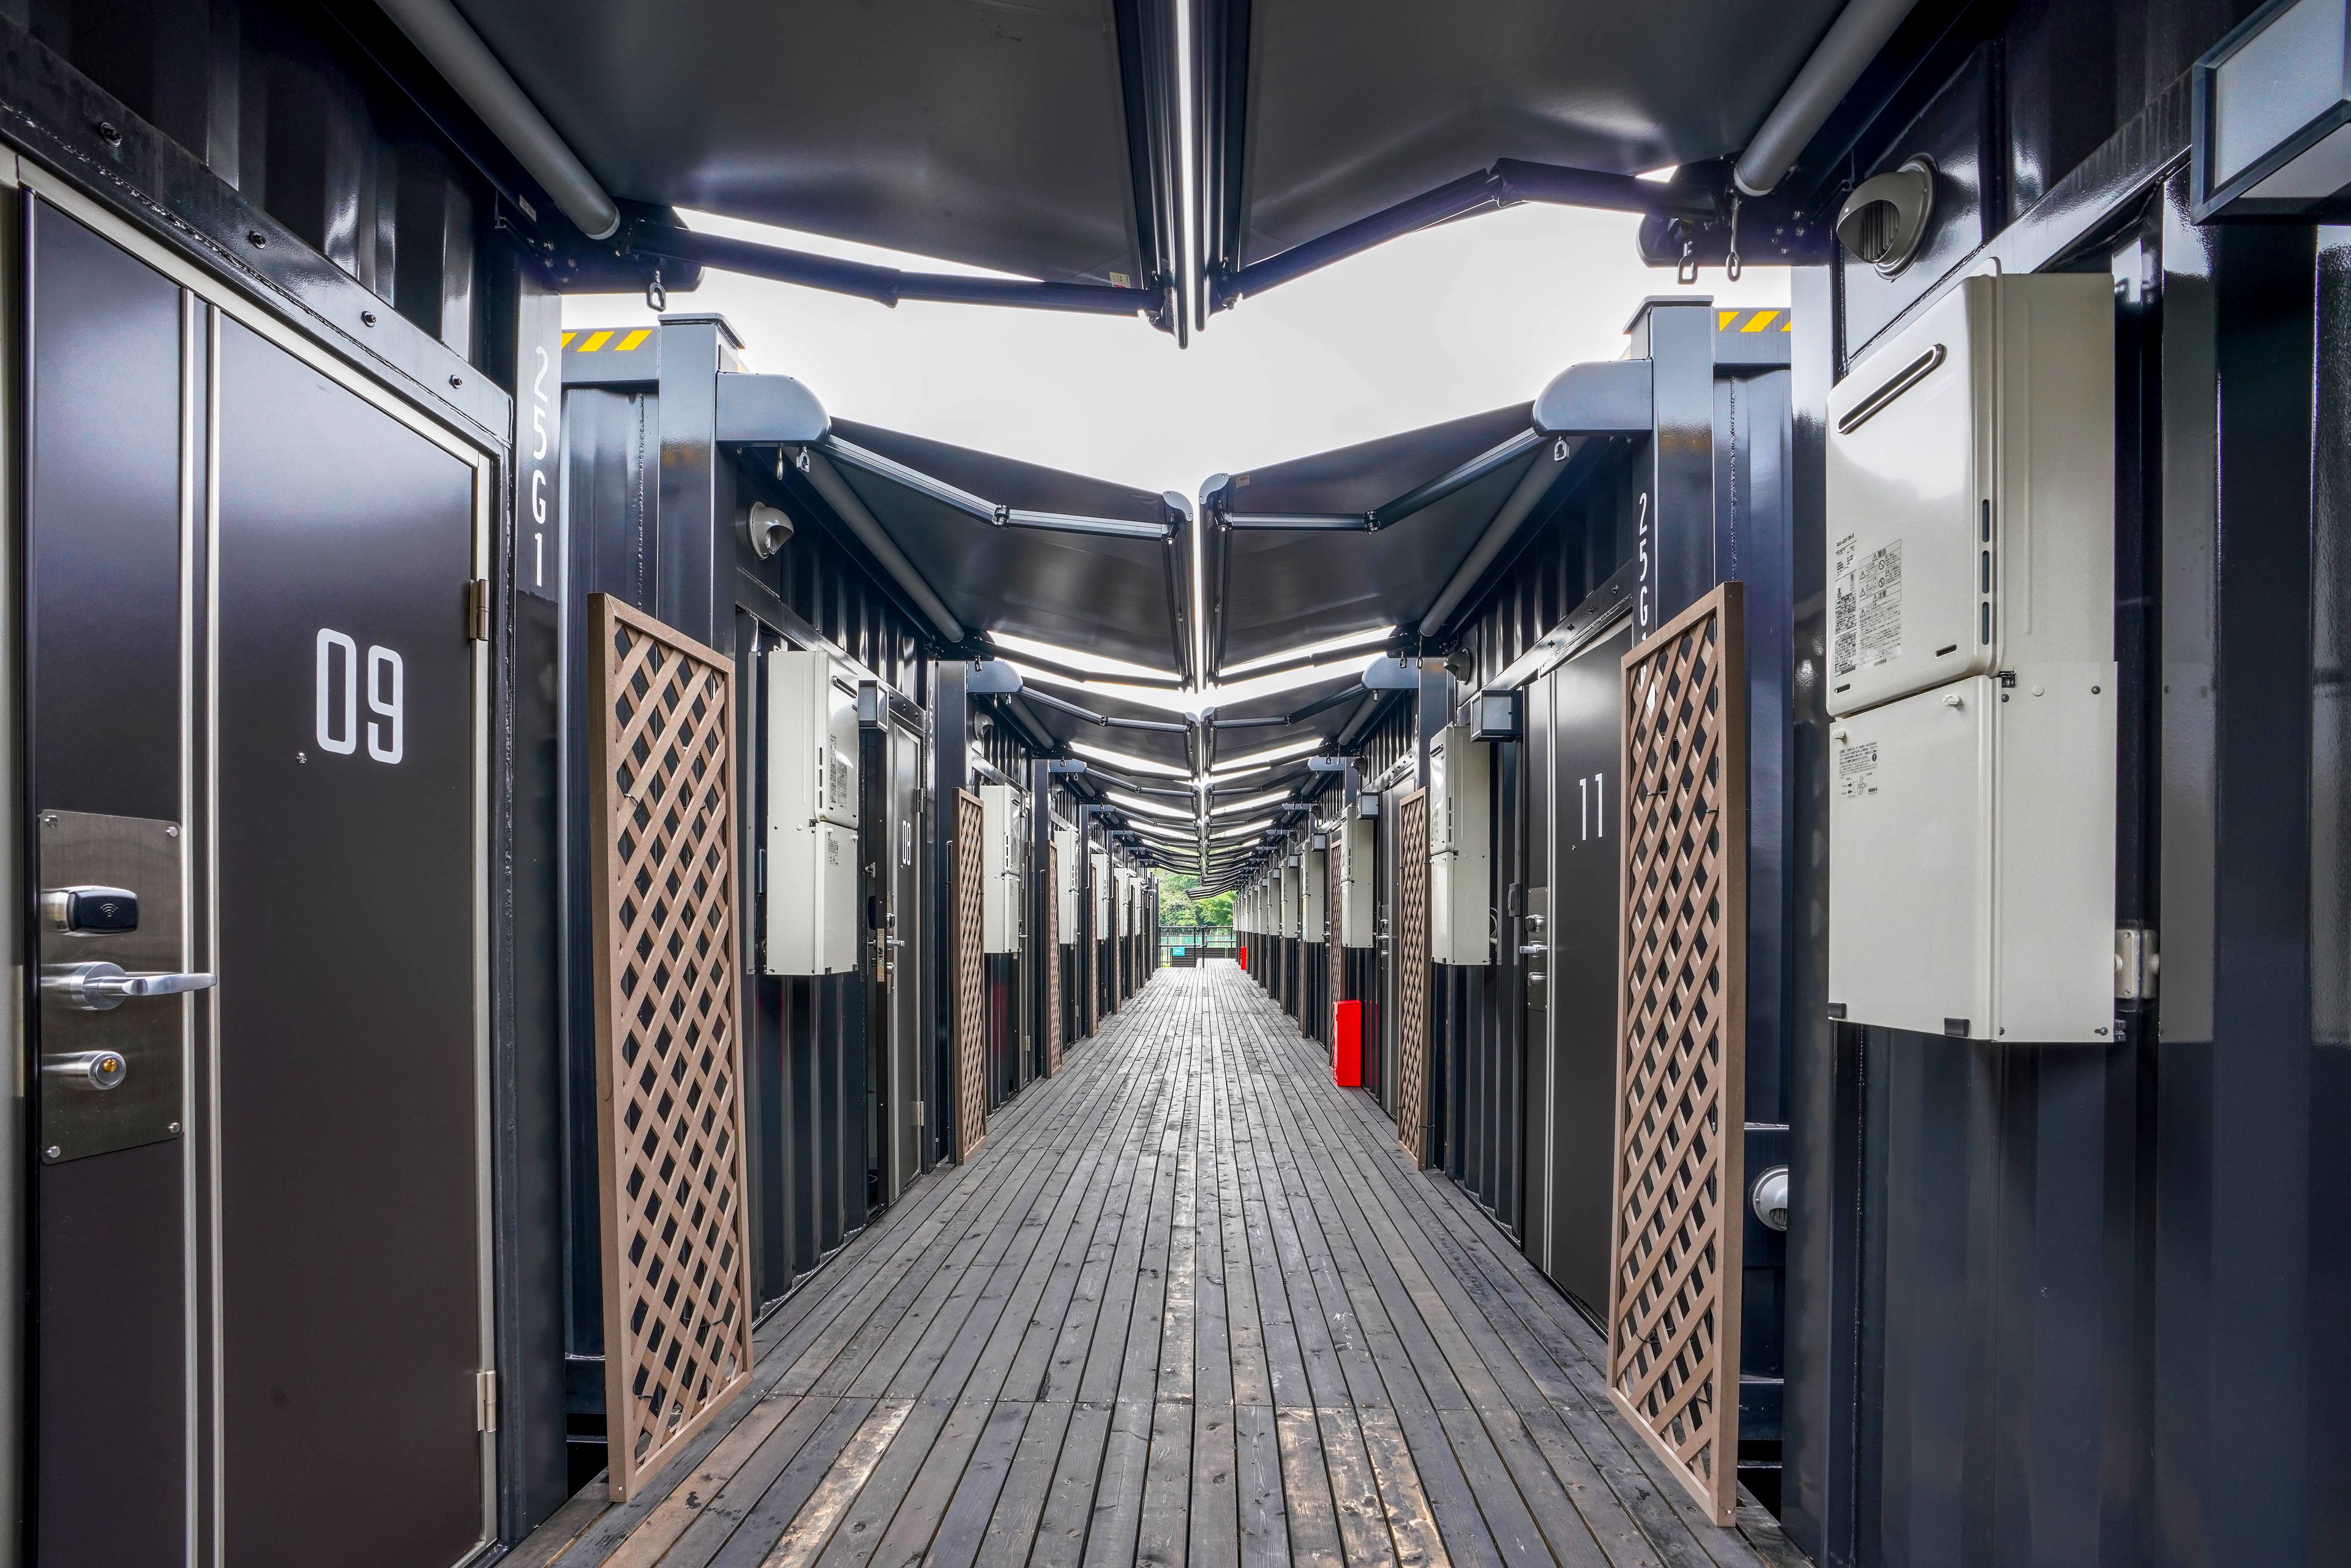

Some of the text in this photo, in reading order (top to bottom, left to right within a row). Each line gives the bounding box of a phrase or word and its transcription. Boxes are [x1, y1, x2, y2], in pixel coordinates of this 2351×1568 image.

[532, 345, 549, 587] 25G1
[317, 628, 403, 764] 09
[902, 820, 910, 866] 08
[1580, 773, 1602, 841] 11
